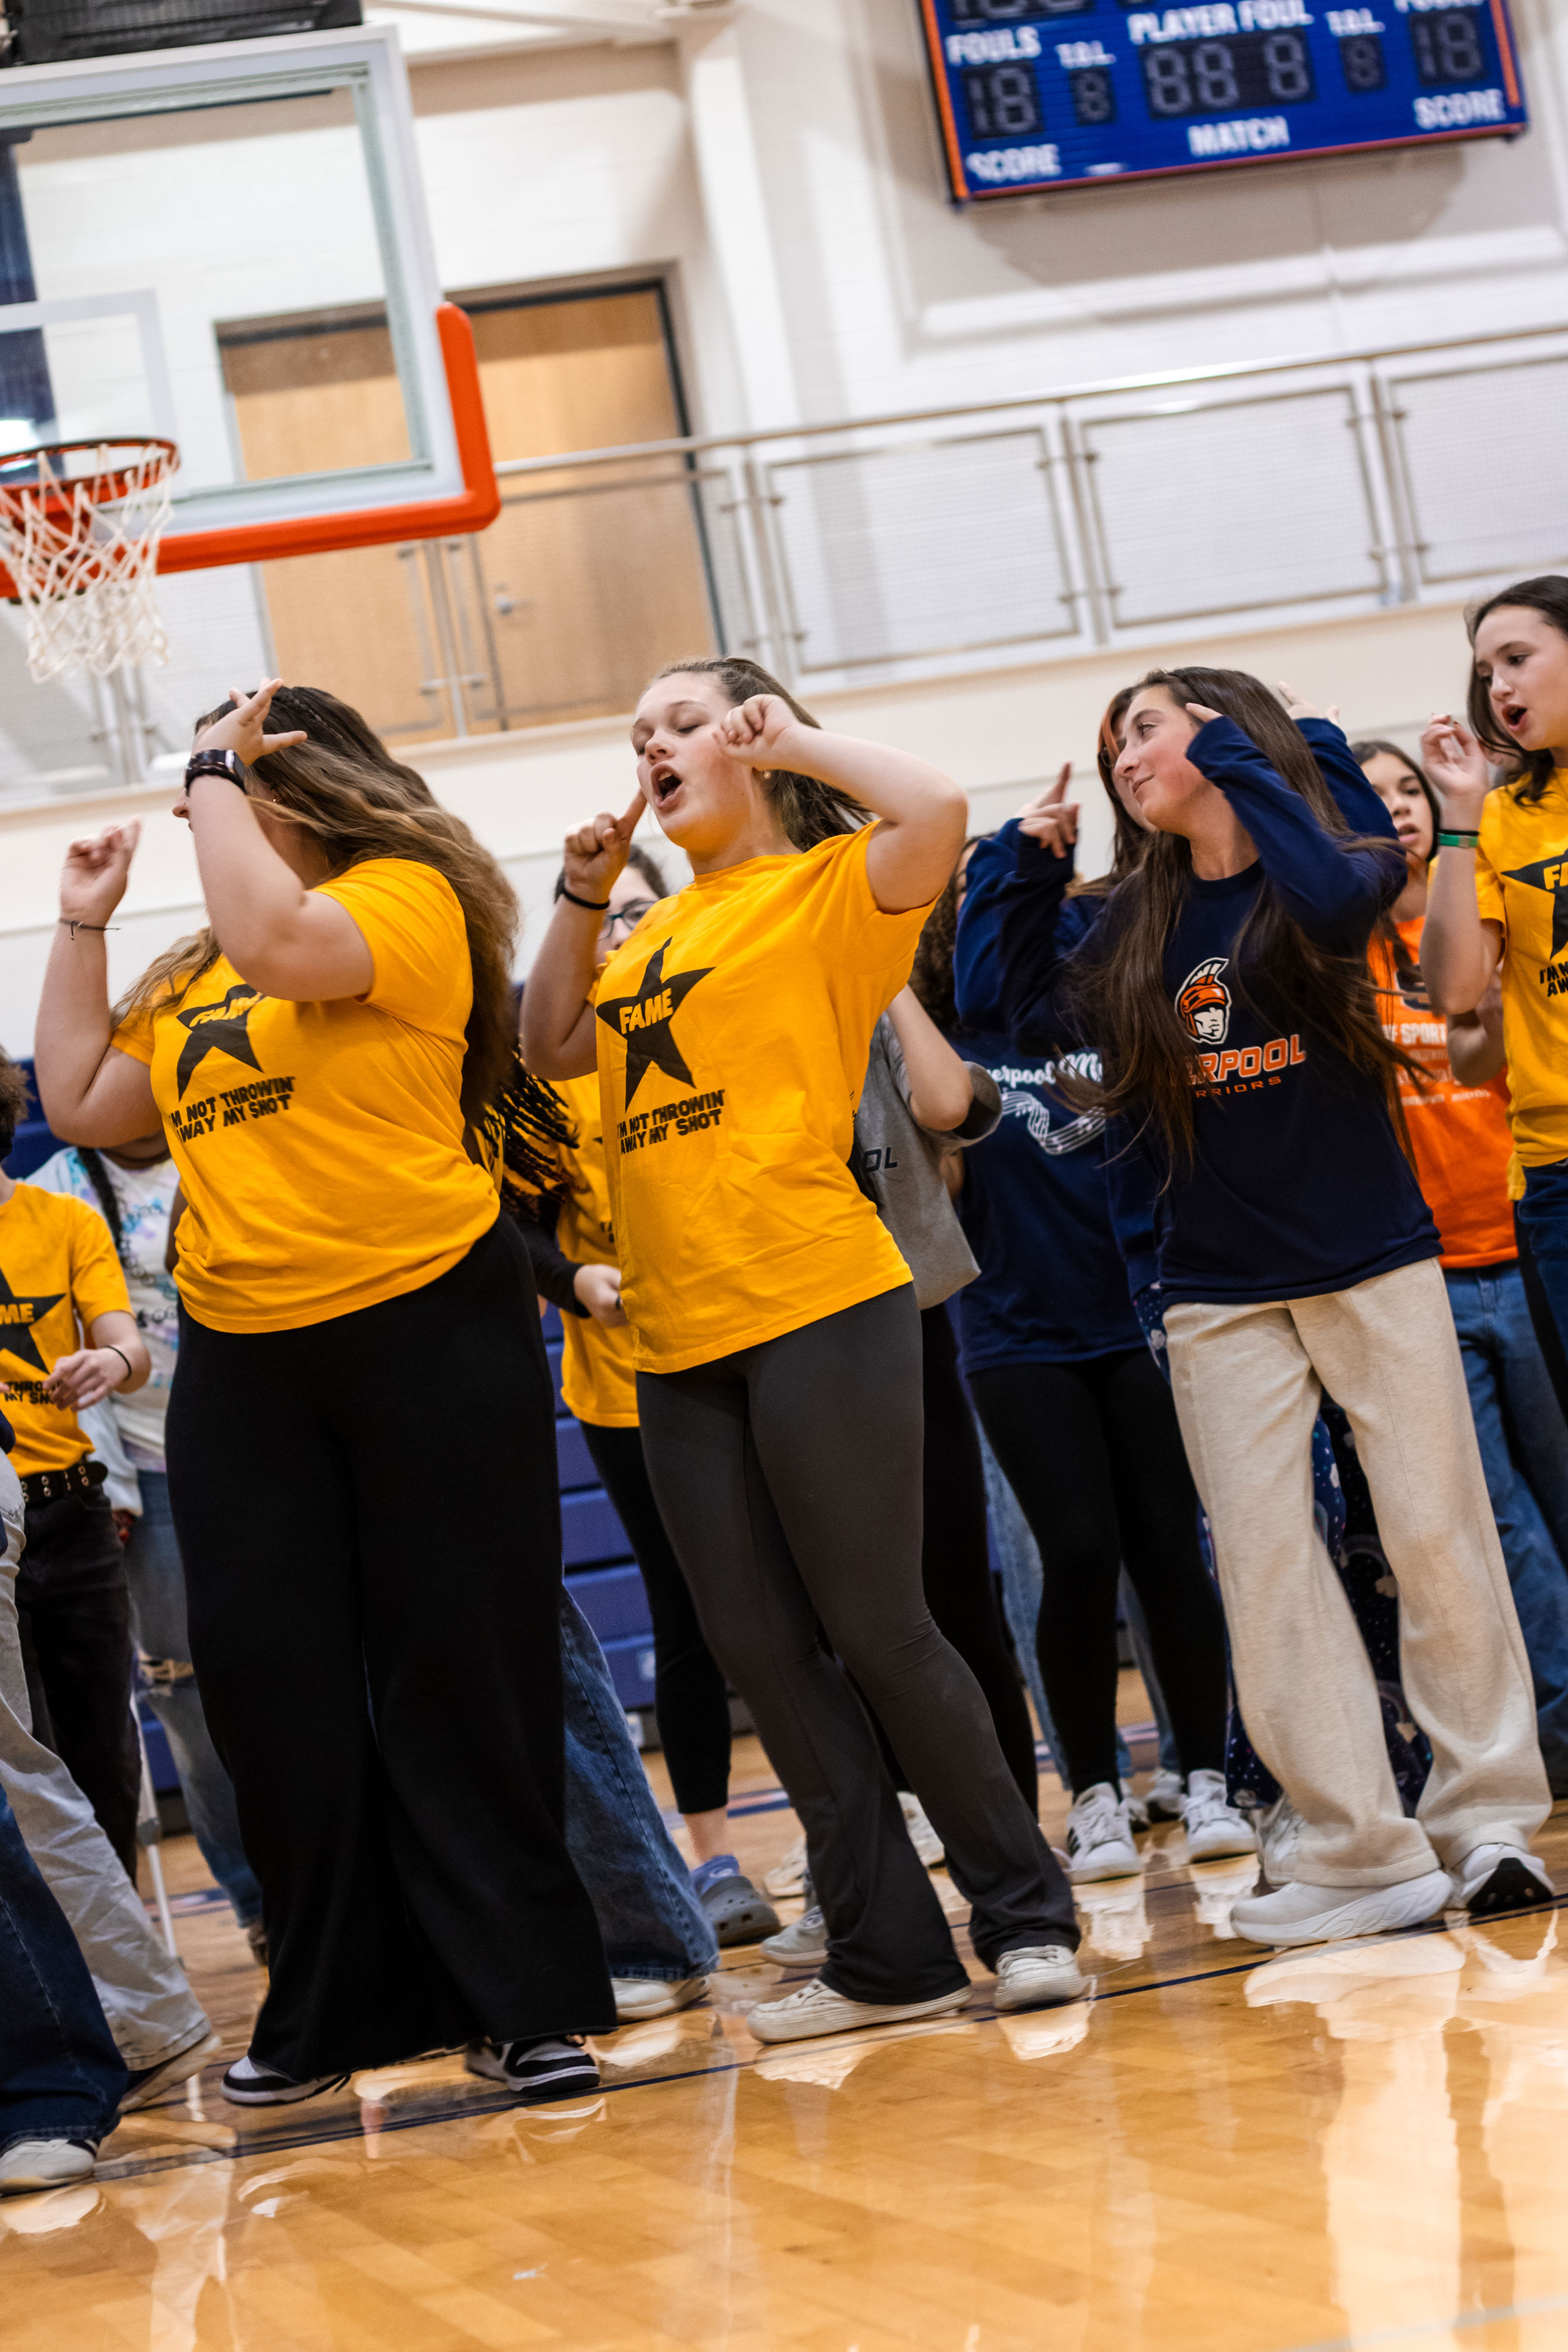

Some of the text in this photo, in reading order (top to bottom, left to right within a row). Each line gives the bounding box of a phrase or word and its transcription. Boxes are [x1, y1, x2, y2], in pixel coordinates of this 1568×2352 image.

[1126, 2, 1239, 45] PLAYER
[1237, 0, 1315, 32] FOUL
[945, 26, 1042, 67] FOULS
[1411, 88, 1507, 130] SCORE
[1187, 115, 1290, 157] MATCH
[966, 143, 1062, 183] SCORE
[619, 987, 673, 1034] FAME
[987, 1061, 1056, 1089] erpool
[1195, 1076, 1282, 1098] RRIORS
[186, 1096, 216, 1122] NOT
[223, 1105, 247, 1127] MY
[249, 1094, 291, 1119] SHOT
[629, 1113, 650, 1134] NOT
[620, 1108, 722, 1155] AWAY MY SHOT
[0, 1303, 34, 1324] ME
